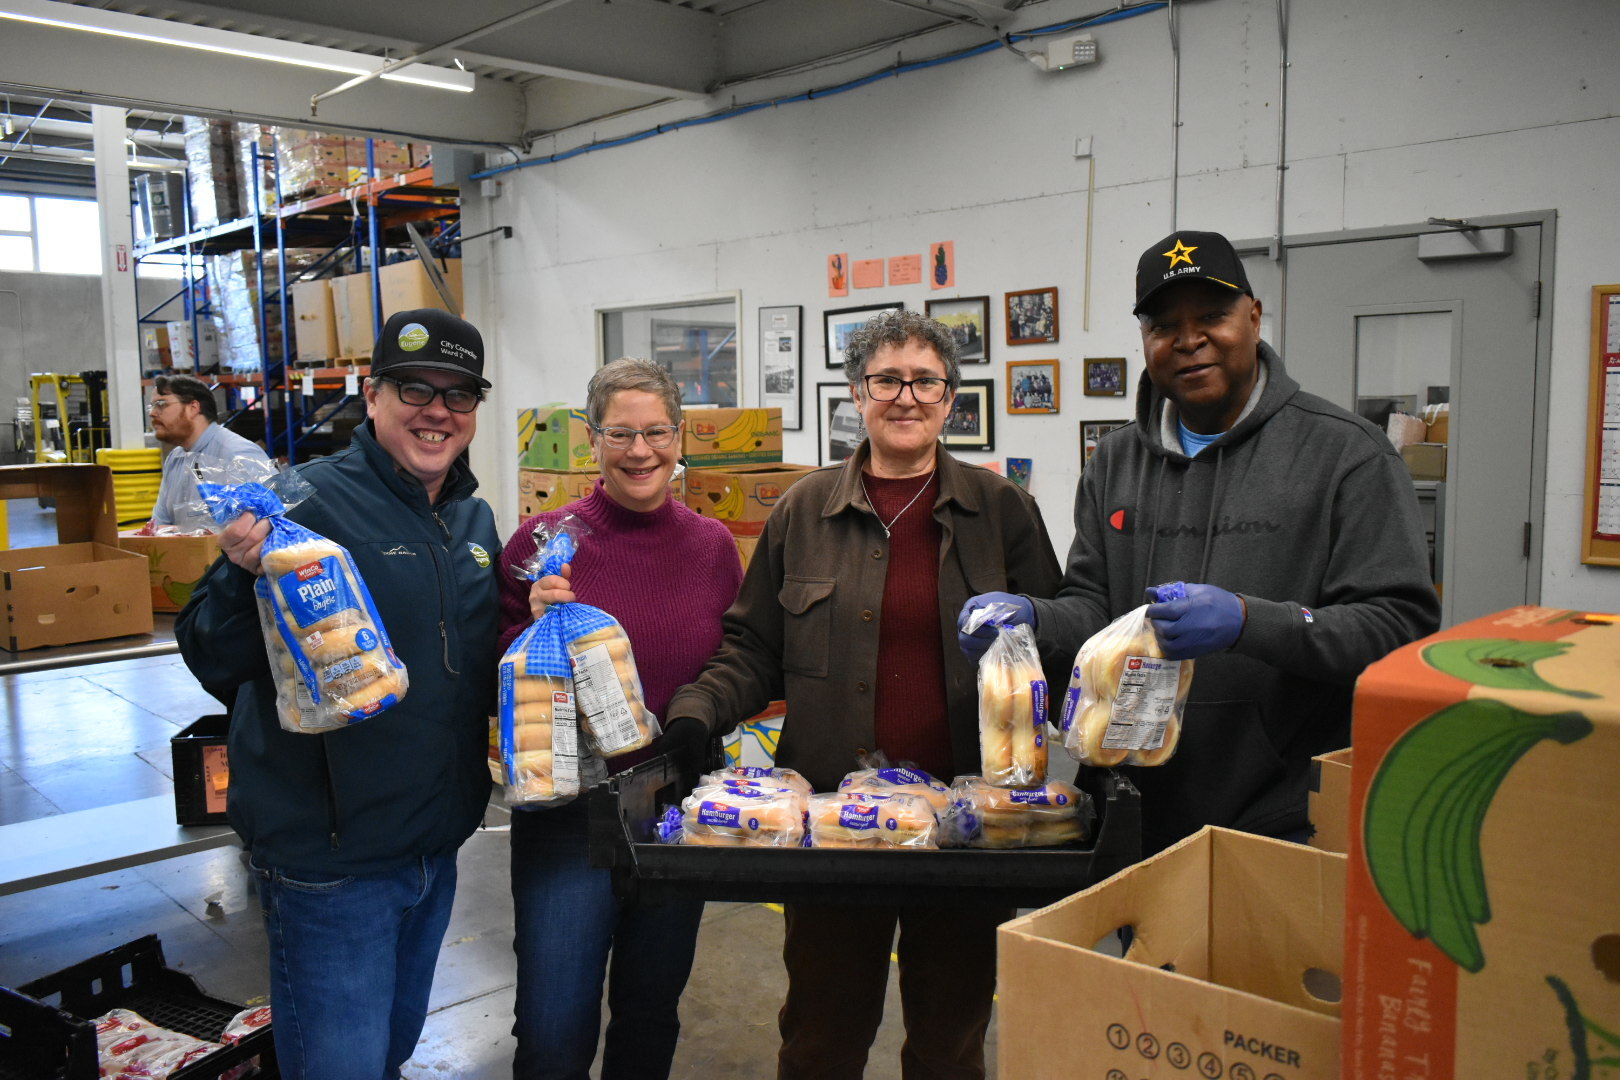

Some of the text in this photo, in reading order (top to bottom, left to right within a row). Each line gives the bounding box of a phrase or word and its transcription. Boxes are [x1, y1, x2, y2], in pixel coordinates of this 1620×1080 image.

[1163, 266, 1201, 279] U.S. ARMY
[401, 340, 425, 348] Eugene
[440, 340, 454, 350] City
[440, 347, 459, 356] Ward
[696, 423, 716, 434] Dole
[760, 487, 780, 498] Dole
[298, 564, 319, 577] WinCo
[297, 577, 336, 603] Plain
[312, 595, 336, 611] bagels
[361, 631, 369, 640] 6
[701, 808, 736, 820] Hamburger
[1223, 1029, 1301, 1069] PACKER
